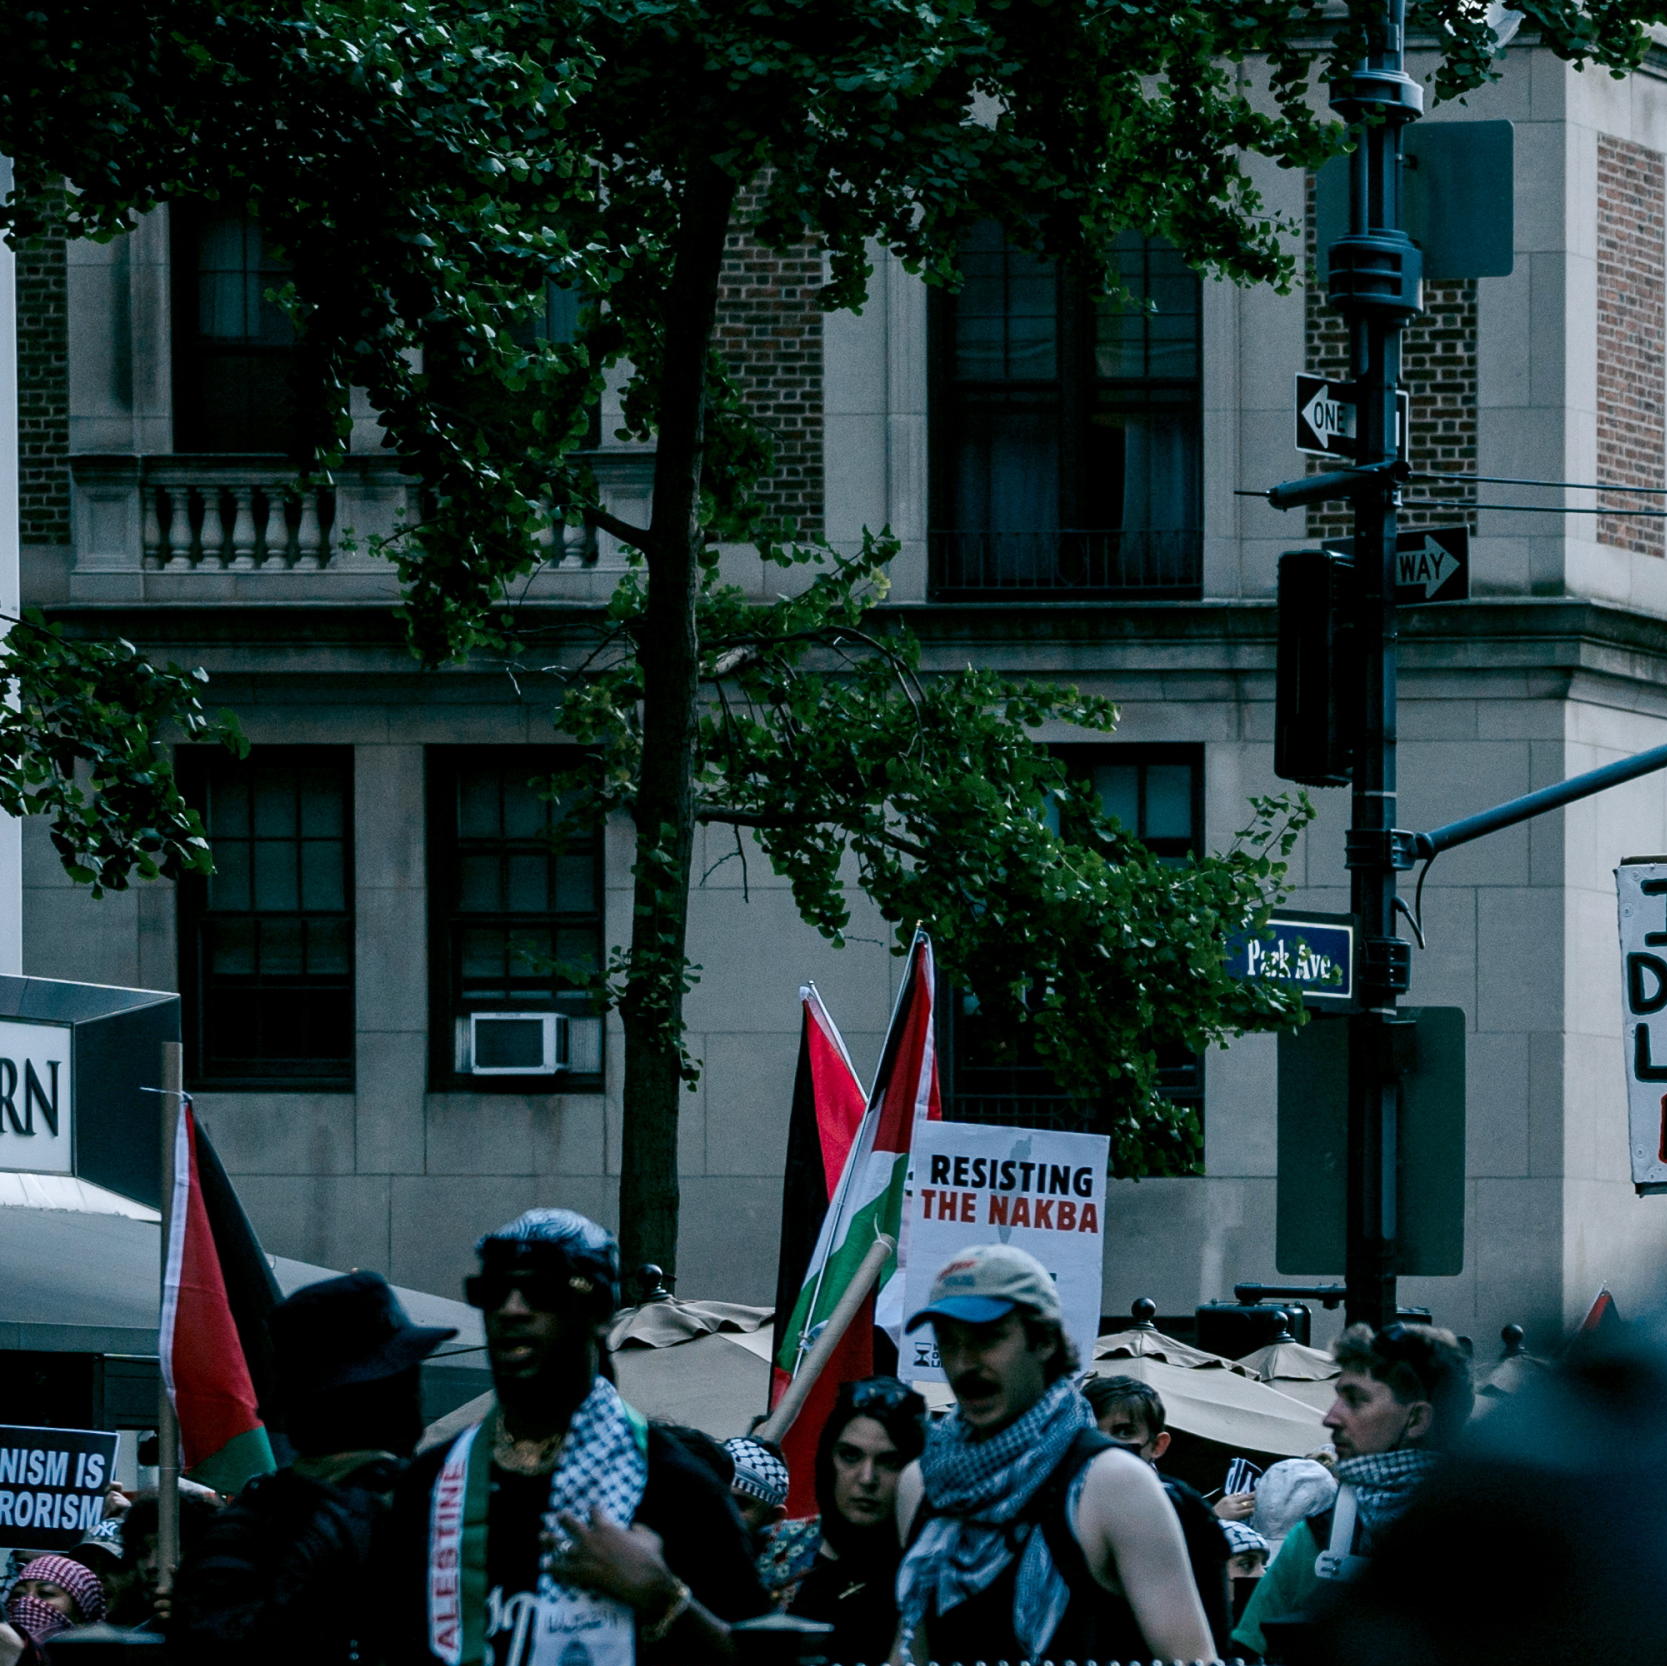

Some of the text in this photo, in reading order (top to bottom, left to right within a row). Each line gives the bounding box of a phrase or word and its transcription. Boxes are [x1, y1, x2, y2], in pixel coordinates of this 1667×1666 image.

[1314, 402, 1344, 433] ONE
[1400, 552, 1445, 582] WAY
[1247, 938, 1331, 980] Park Ave
[931, 1154, 1093, 1197] RESISTING
[921, 1189, 1098, 1233] THE NAKBA
[75, 1452, 105, 1489] IS
